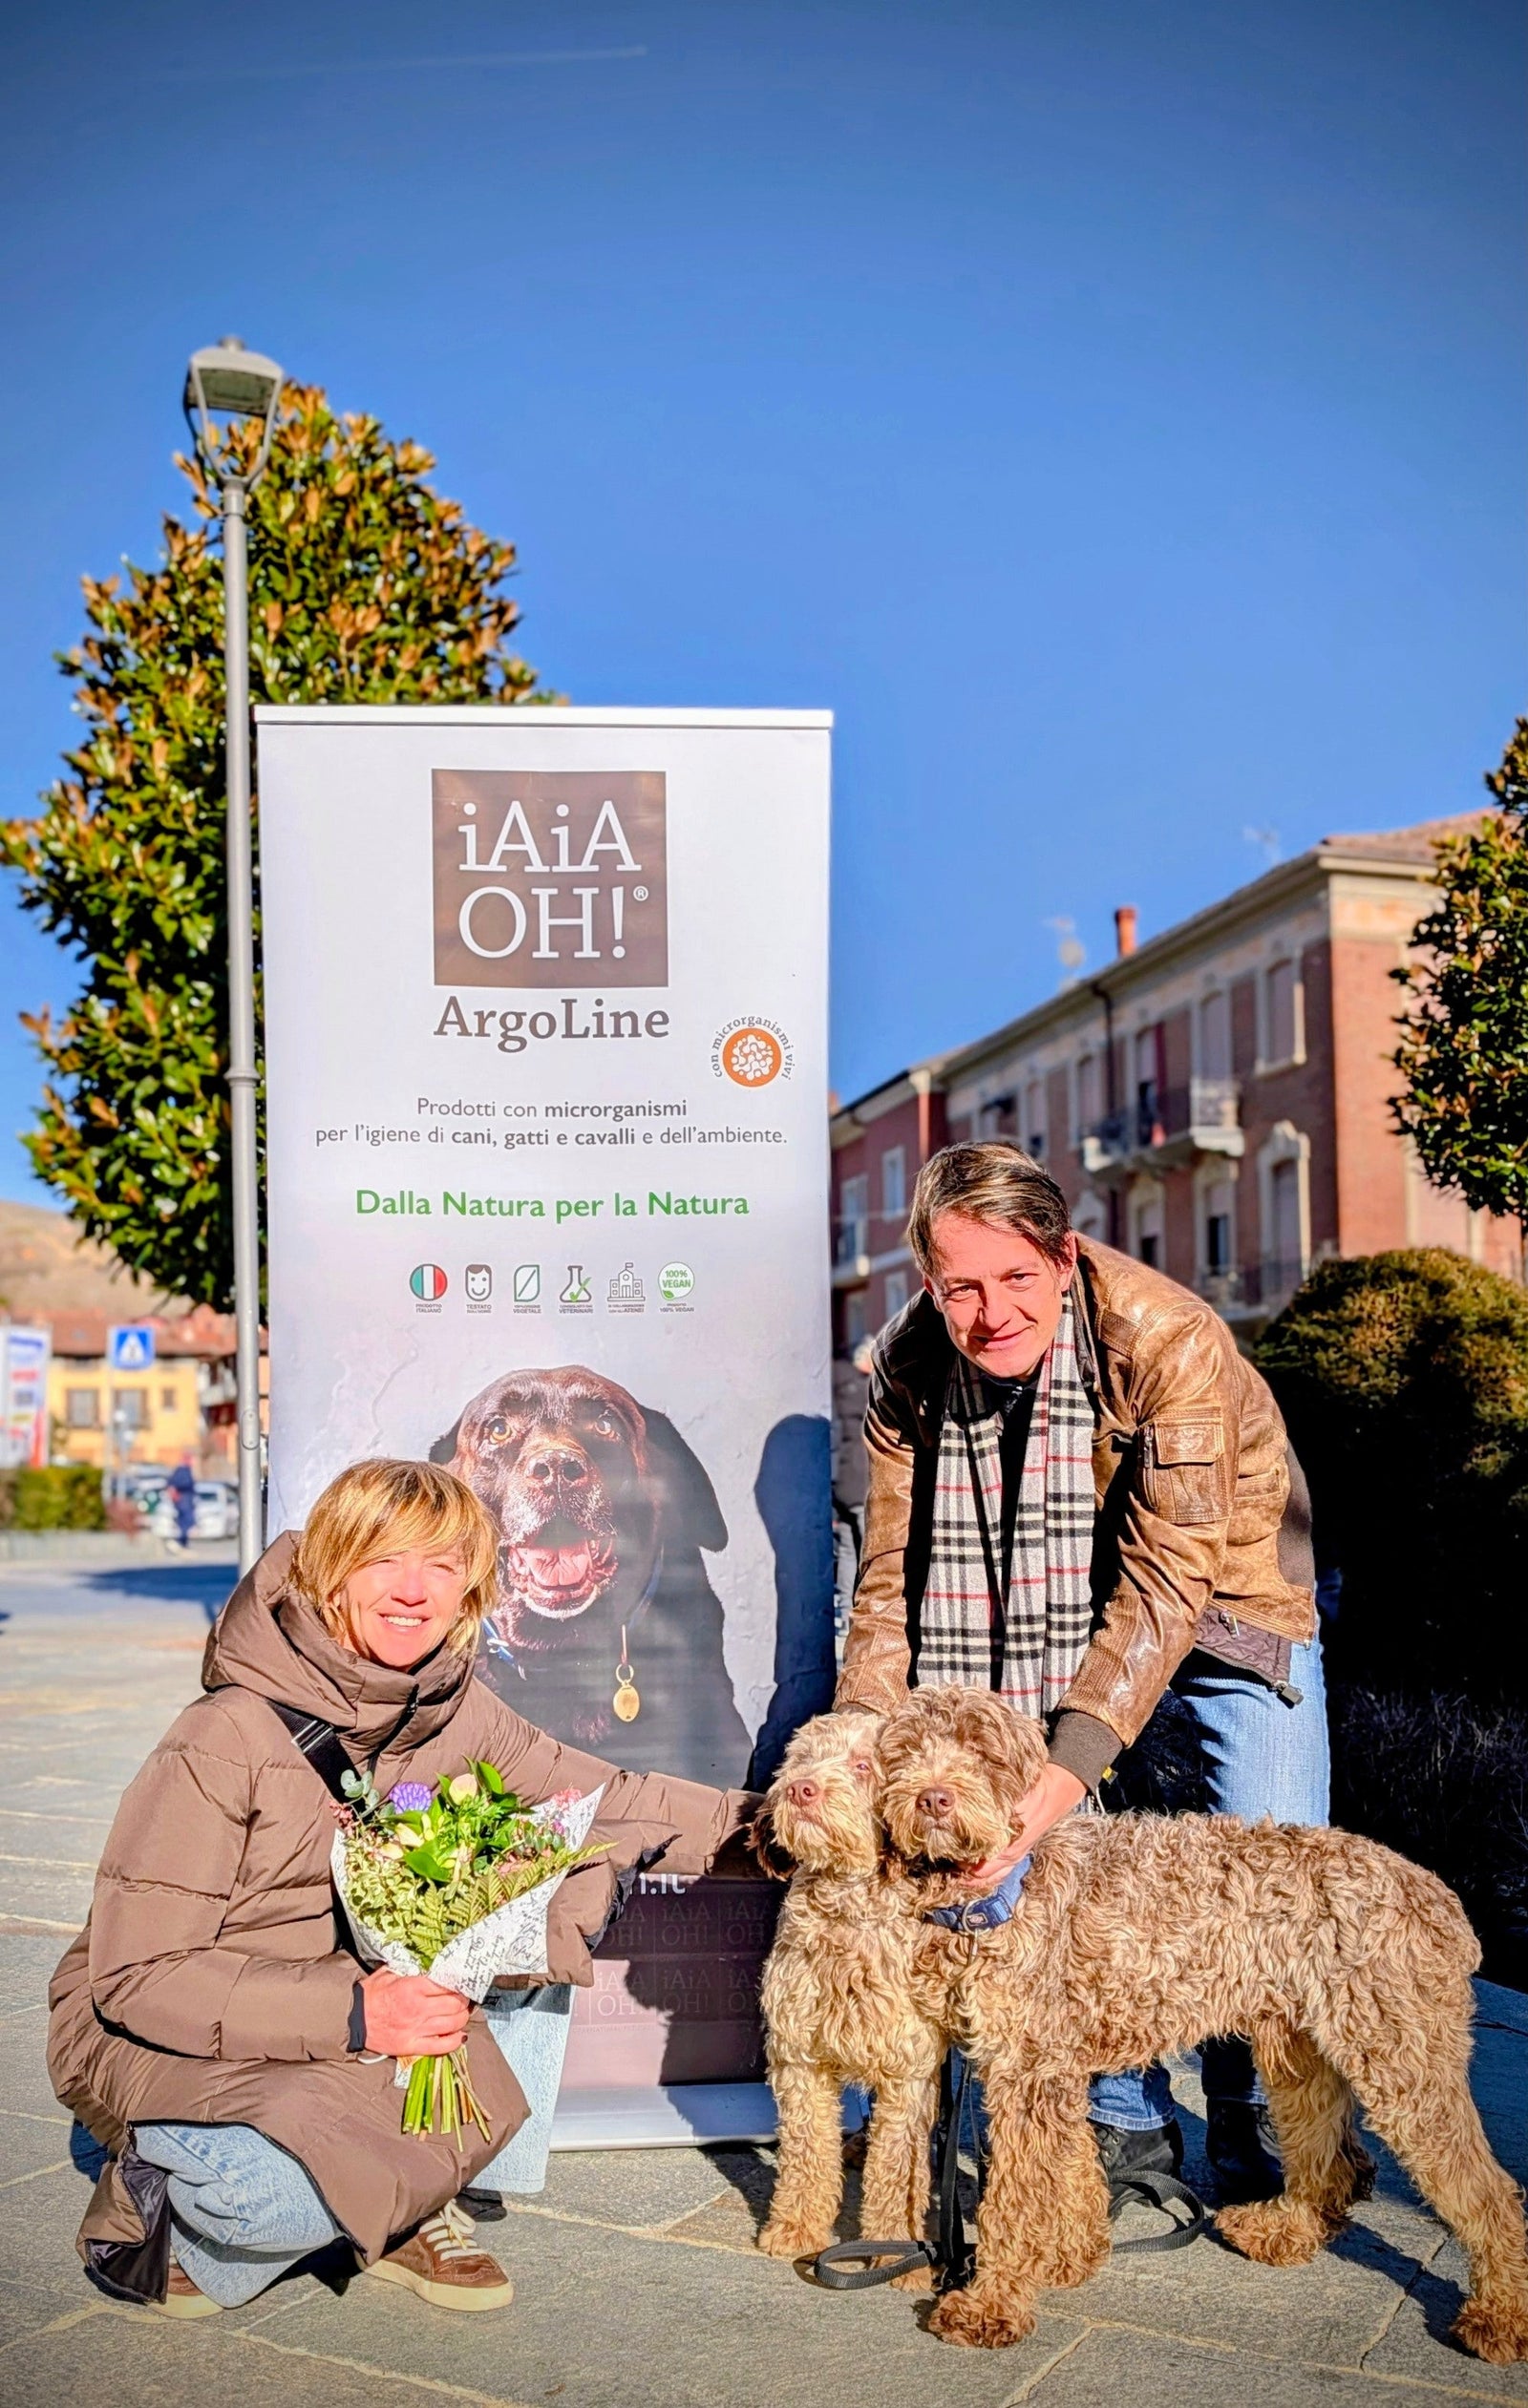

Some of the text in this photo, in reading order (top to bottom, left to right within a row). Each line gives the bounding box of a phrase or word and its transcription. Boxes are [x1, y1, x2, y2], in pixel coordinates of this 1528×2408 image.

[457, 799, 643, 873] iAiA
[434, 995, 669, 1053] ArgoLine
[711, 1015, 796, 1081] con microrganismi vivi
[417, 1097, 687, 1122] Prodotti con microrganismi
[316, 1124, 788, 1150] per l'igiene di cani, gatti e cavalli e dell'ambiente.
[356, 1190, 750, 1223] Dalla Natura per la Natura
[662, 1279, 691, 1288] VEGAN
[665, 1269, 688, 1278] 100%
